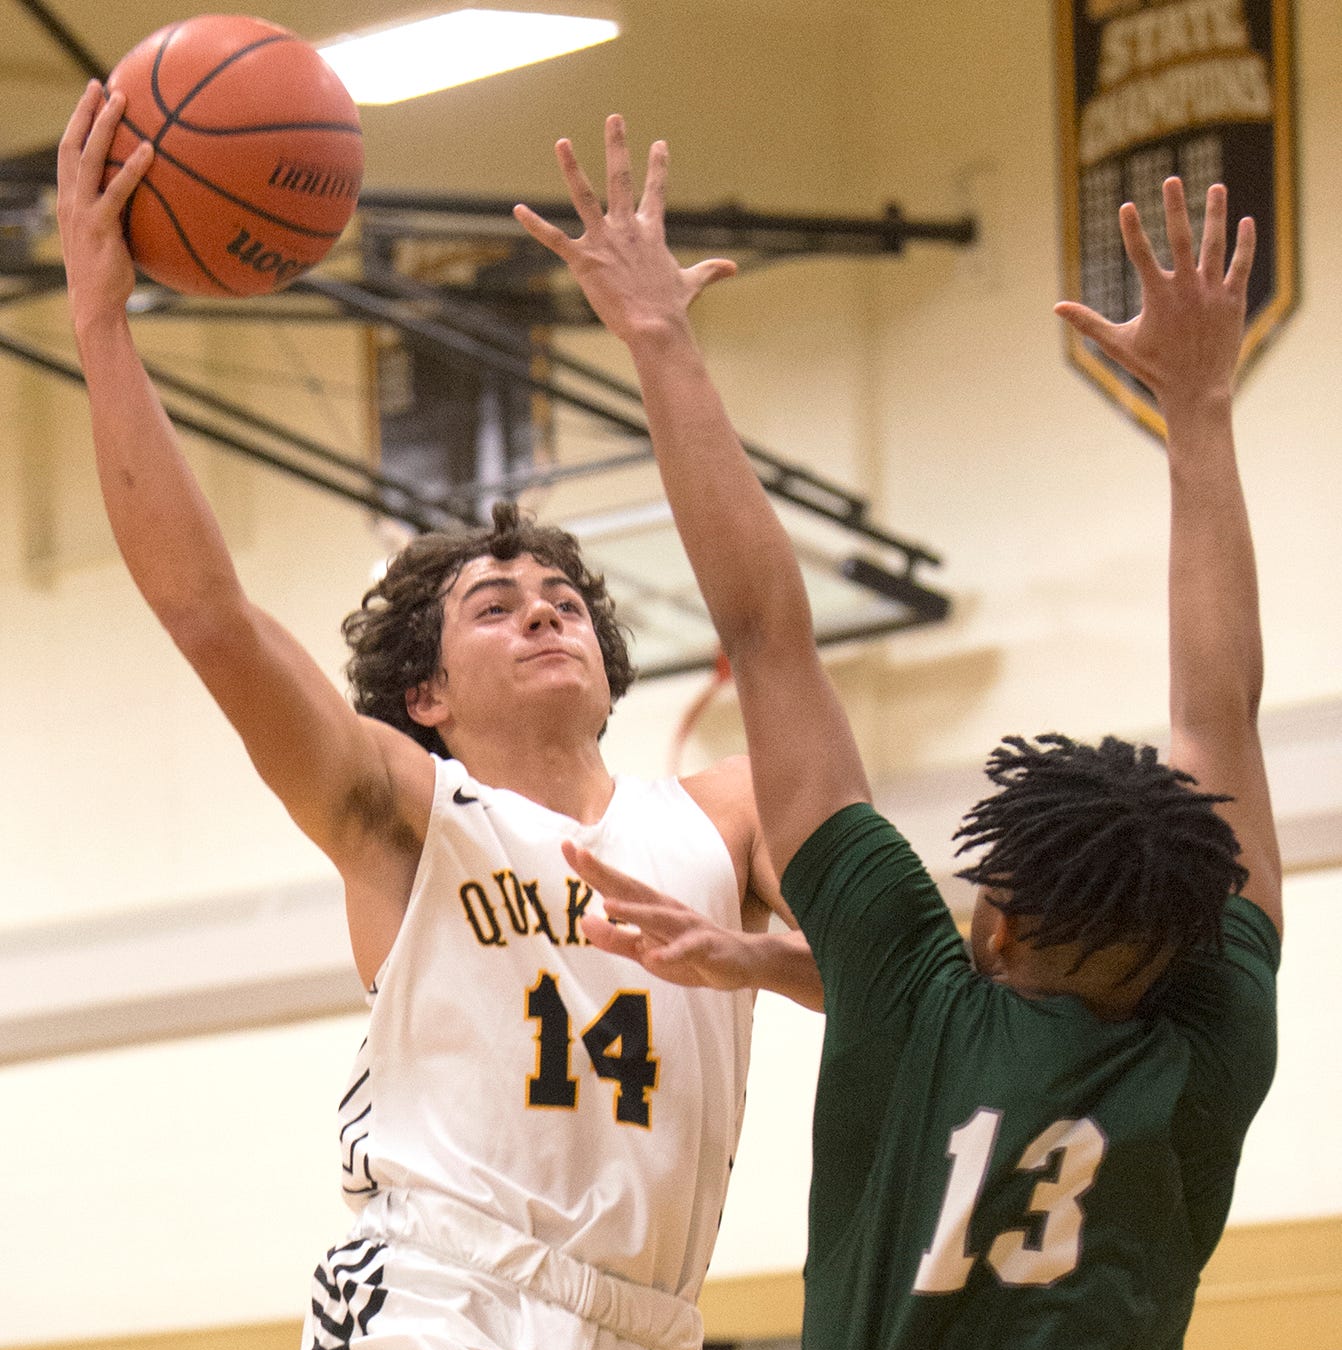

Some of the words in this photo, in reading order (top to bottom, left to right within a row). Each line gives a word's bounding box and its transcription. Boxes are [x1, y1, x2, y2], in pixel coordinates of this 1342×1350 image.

[459, 868, 618, 947] QUAK
[524, 968, 661, 1131] 14
[910, 1105, 1108, 1296] 13
